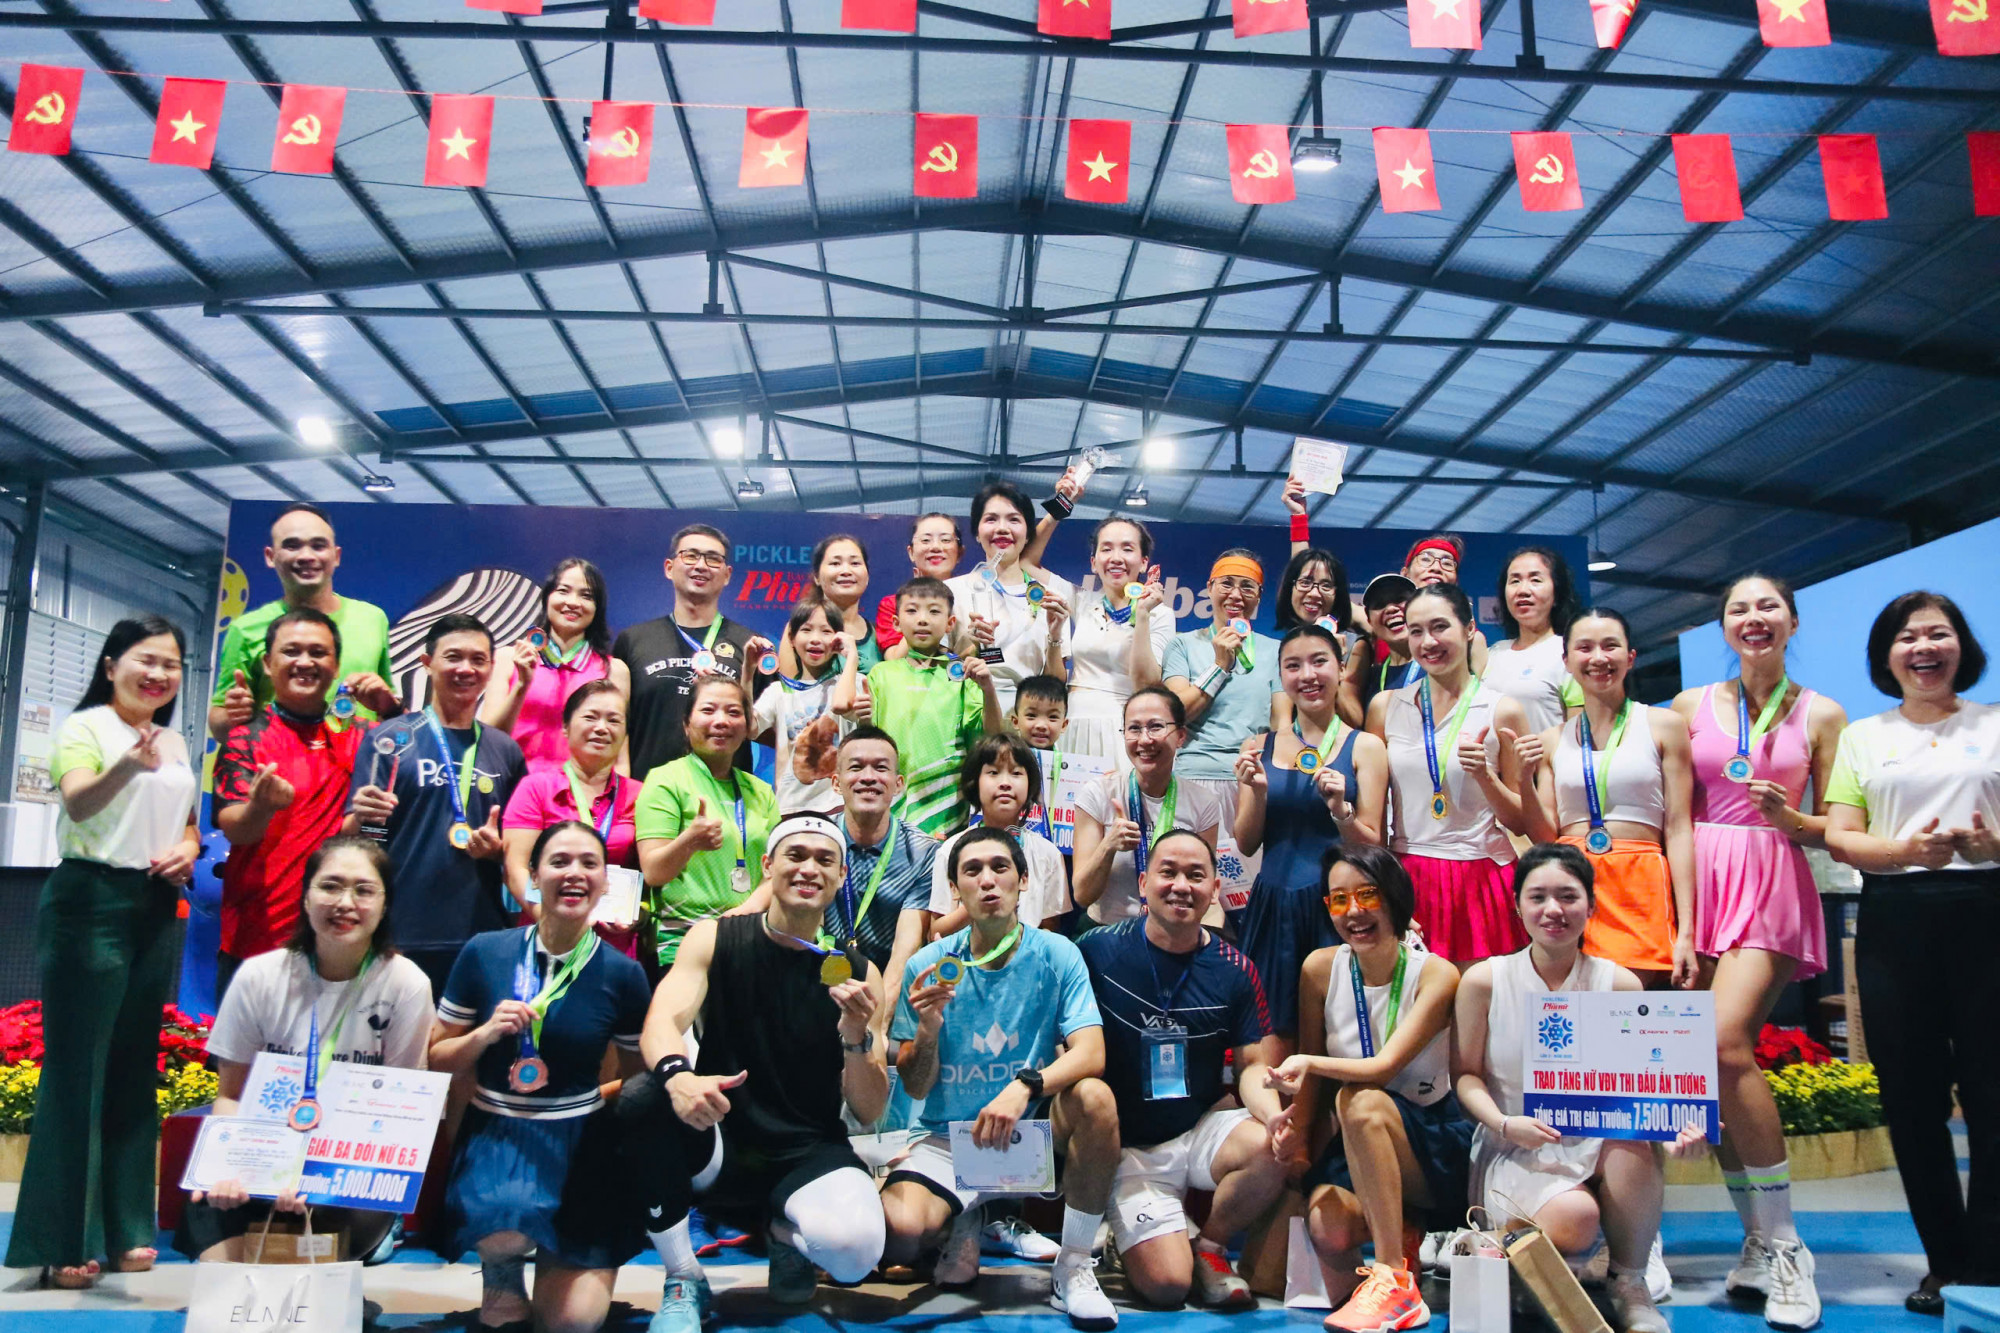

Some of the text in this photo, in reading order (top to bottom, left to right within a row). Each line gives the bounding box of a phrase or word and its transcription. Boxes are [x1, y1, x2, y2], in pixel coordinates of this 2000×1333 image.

[734, 545, 812, 564] PICKLE
[645, 660, 667, 675] BCB
[677, 686, 690, 695] TE
[1533, 1067, 1706, 1098] TRAO TẶNG NỮ VĐV THI ĐẤU ẤN TƯỢNG
[1534, 1102, 1707, 1133] TỔNG GIÁ TRỊ GIẢI THƯỞNG 7.500.000đ
[307, 1135, 333, 1157] GIẢI
[333, 1140, 353, 1160] BA
[353, 1140, 376, 1162] ĐÔI
[377, 1144, 400, 1163] NỮ
[397, 1147, 419, 1166] 6.5
[330, 1168, 410, 1202] 5.000.000đ
